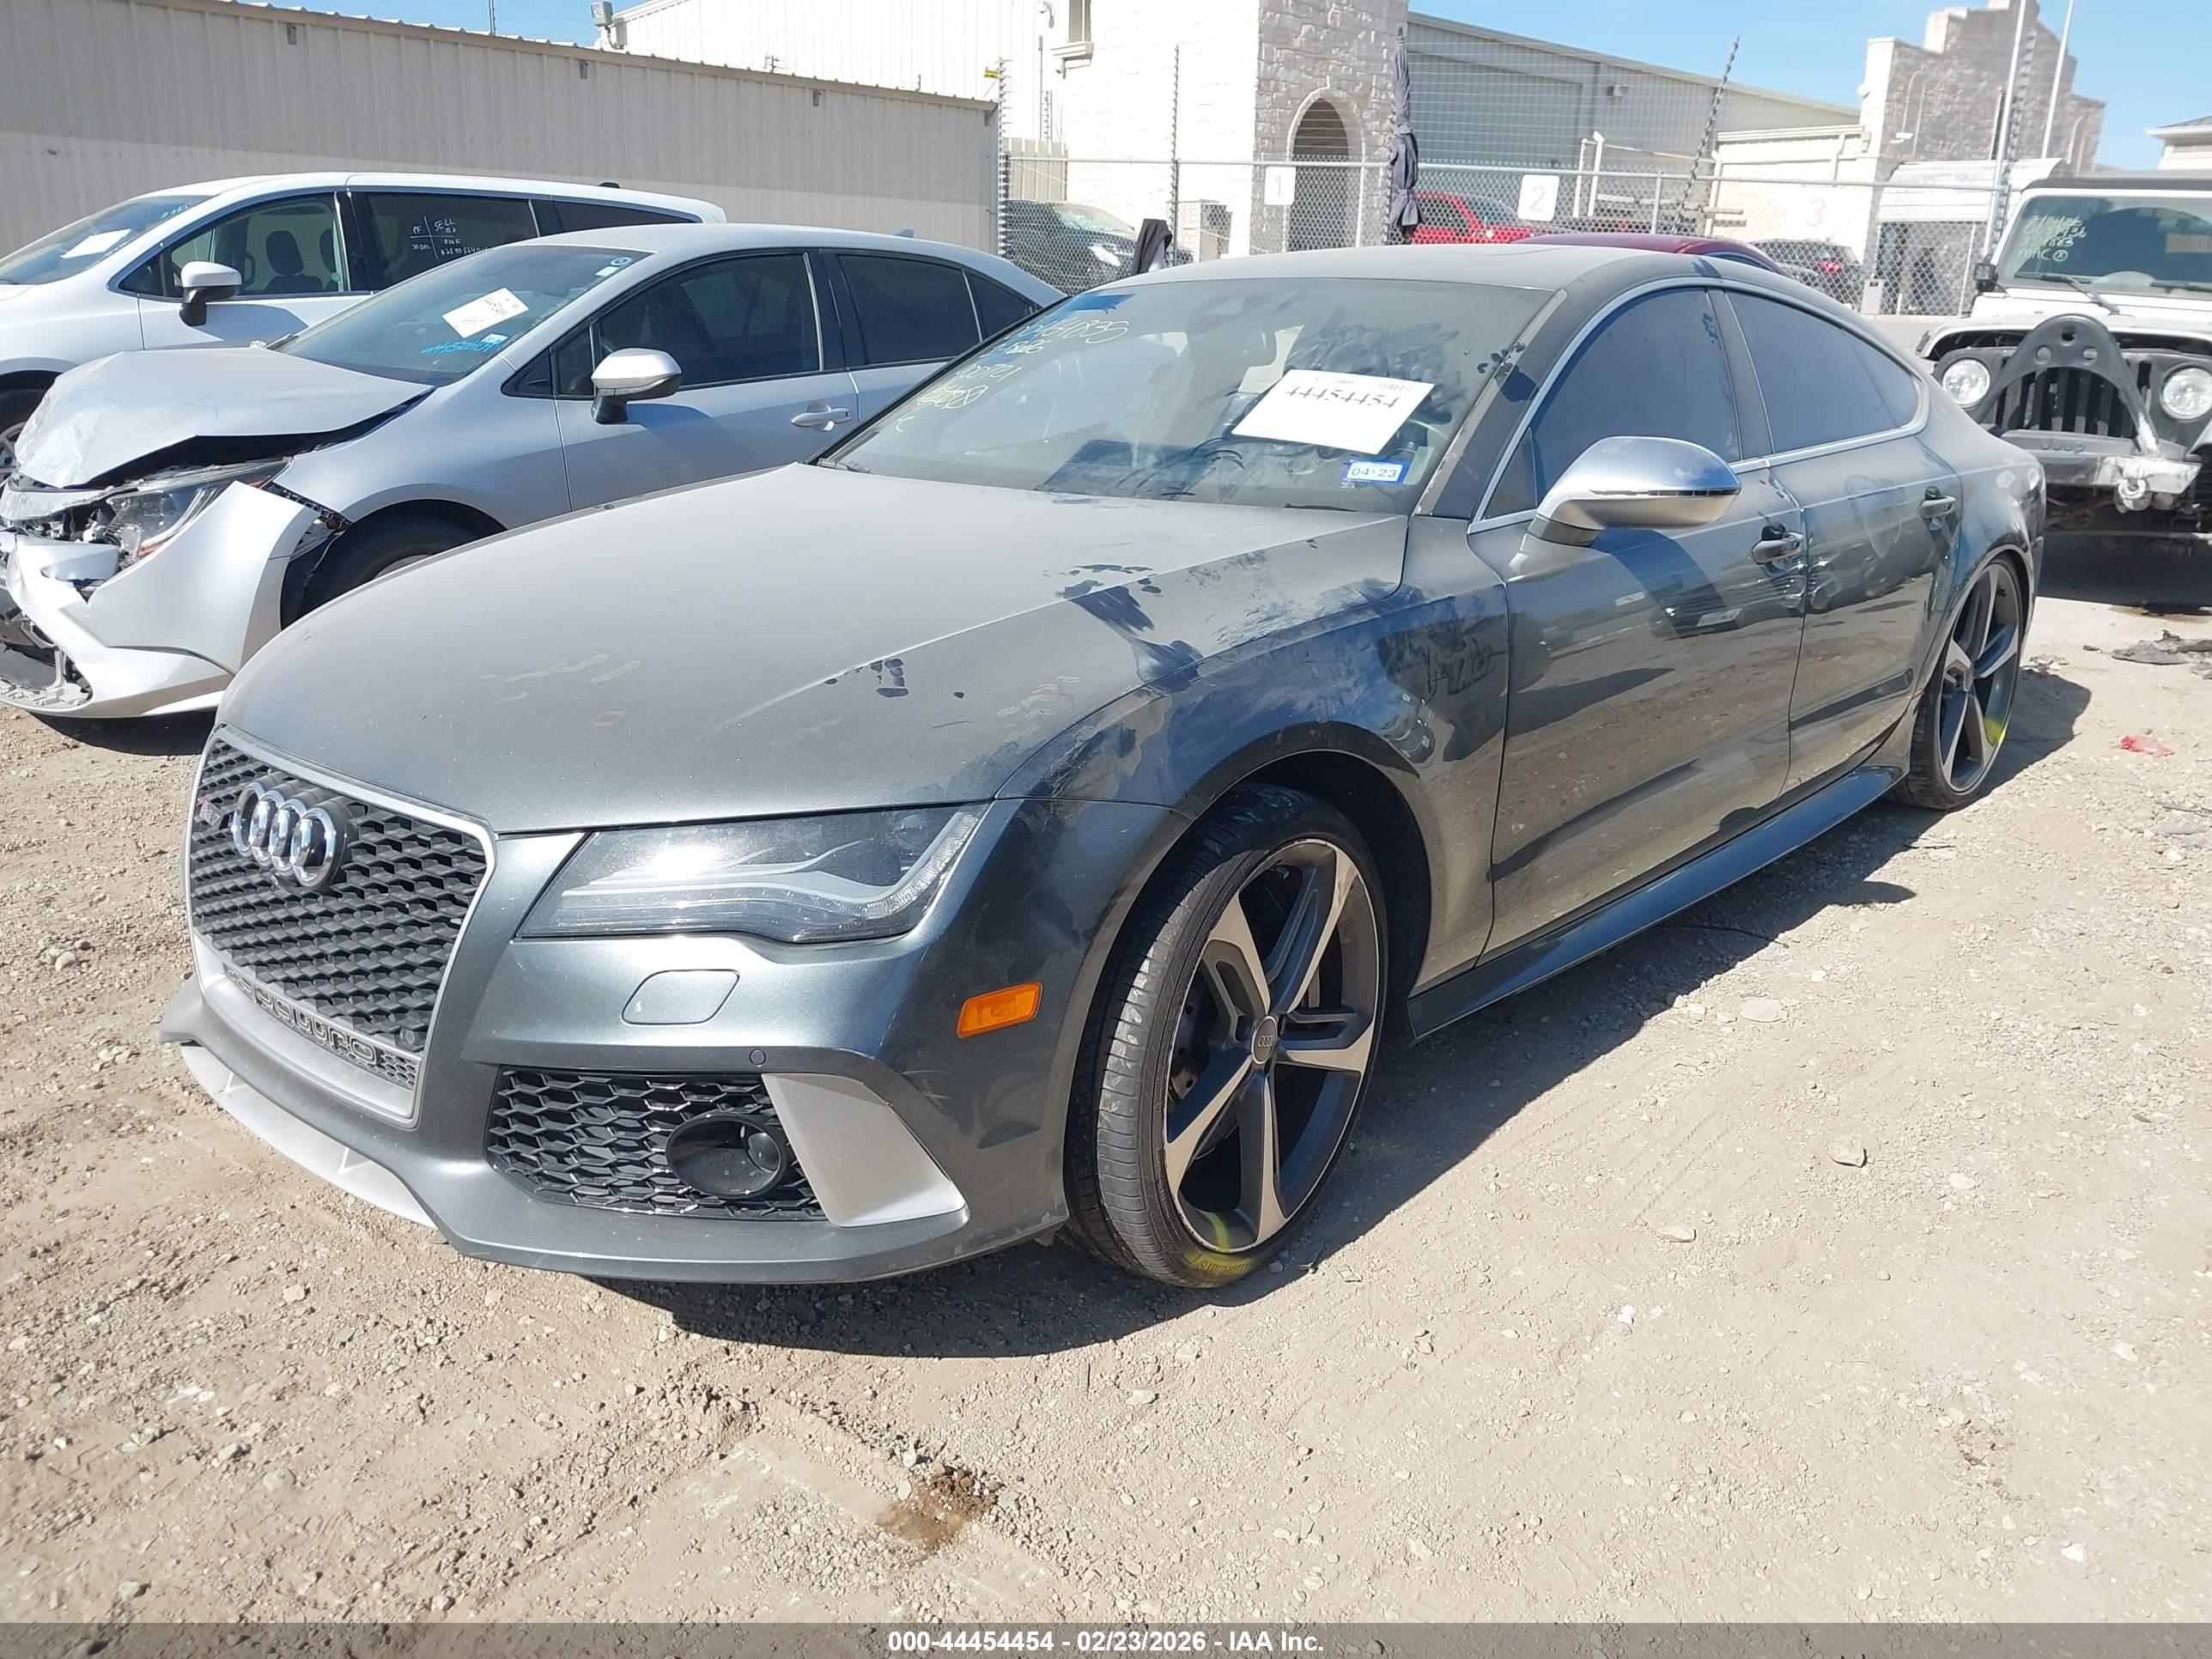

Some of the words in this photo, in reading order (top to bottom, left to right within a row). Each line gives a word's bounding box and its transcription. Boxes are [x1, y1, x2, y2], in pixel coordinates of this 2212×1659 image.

[1529, 185, 1546, 212] 2
[1806, 198, 1826, 227] 3
[239, 975, 377, 1066] quattro
